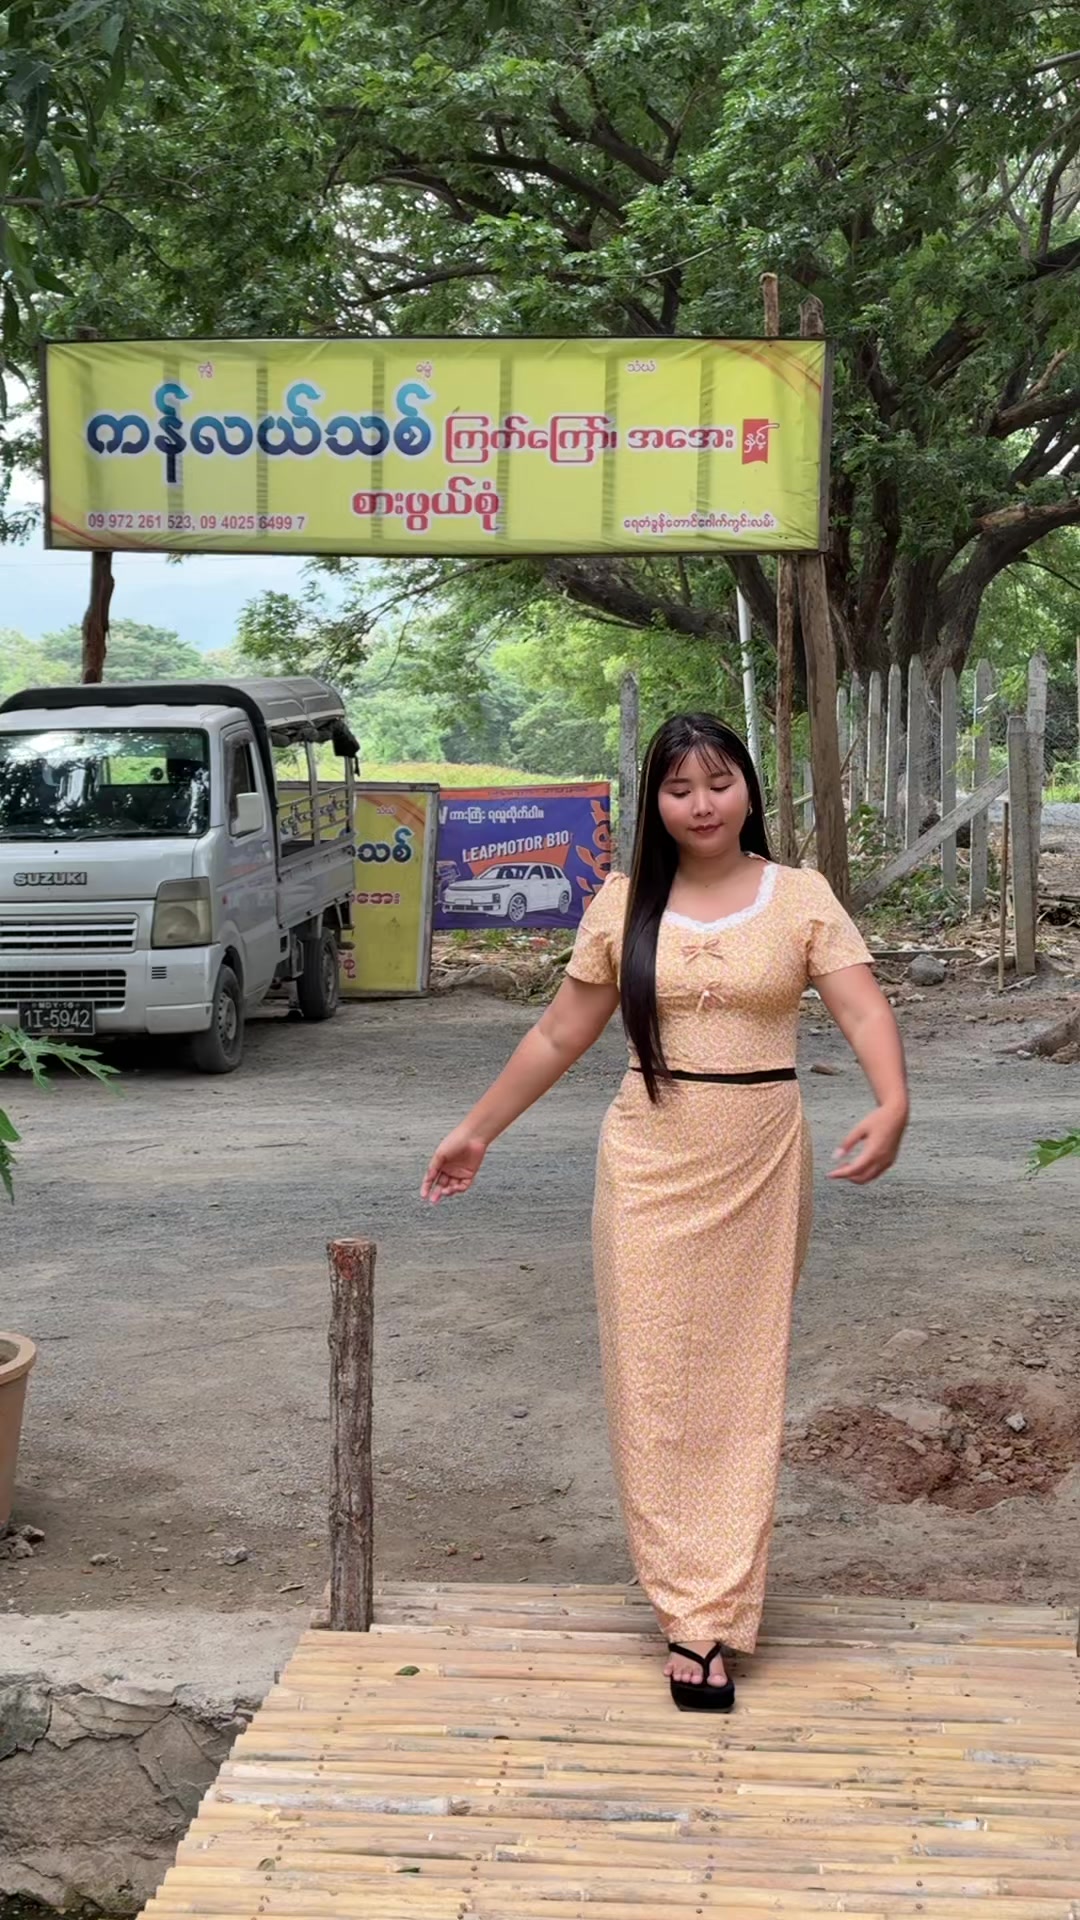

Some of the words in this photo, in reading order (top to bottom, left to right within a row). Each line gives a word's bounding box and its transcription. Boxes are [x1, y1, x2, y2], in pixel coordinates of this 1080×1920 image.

[86, 382, 432, 484] ကန်လယ်သစ်
[628, 428, 735, 449] အအေး
[352, 476, 500, 532] စားဖွယ်စုံ
[88, 514, 105, 529] 09
[108, 514, 134, 529] 972
[138, 514, 162, 529] 261
[167, 514, 196, 531] 523,
[200, 515, 217, 530] 09
[220, 515, 255, 530] 4025
[258, 515, 294, 530] 6499
[296, 515, 305, 530] 7
[462, 835, 543, 863] LEAPMOTOR
[546, 829, 569, 847] B10
[14, 872, 87, 885] SUZUKI
